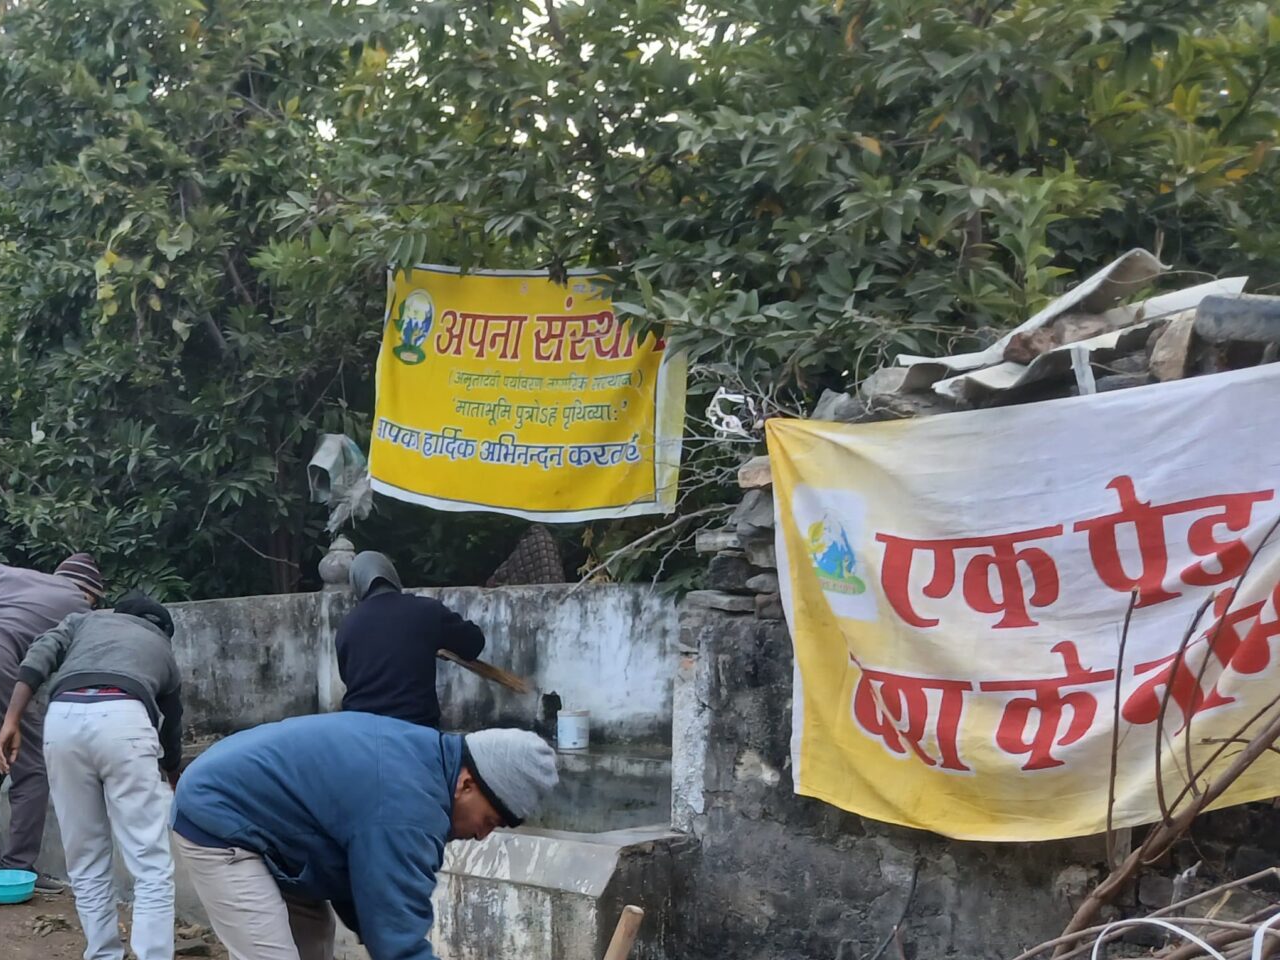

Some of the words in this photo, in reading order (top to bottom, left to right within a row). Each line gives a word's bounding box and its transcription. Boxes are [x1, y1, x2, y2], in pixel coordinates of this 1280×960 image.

[436, 310, 528, 359] अपना
[535, 297, 666, 361] संस्था
[421, 428, 477, 461] हार्दिक
[479, 435, 565, 470] अभिनन्दन
[875, 525, 1063, 629] एक
[979, 641, 1116, 772] के
